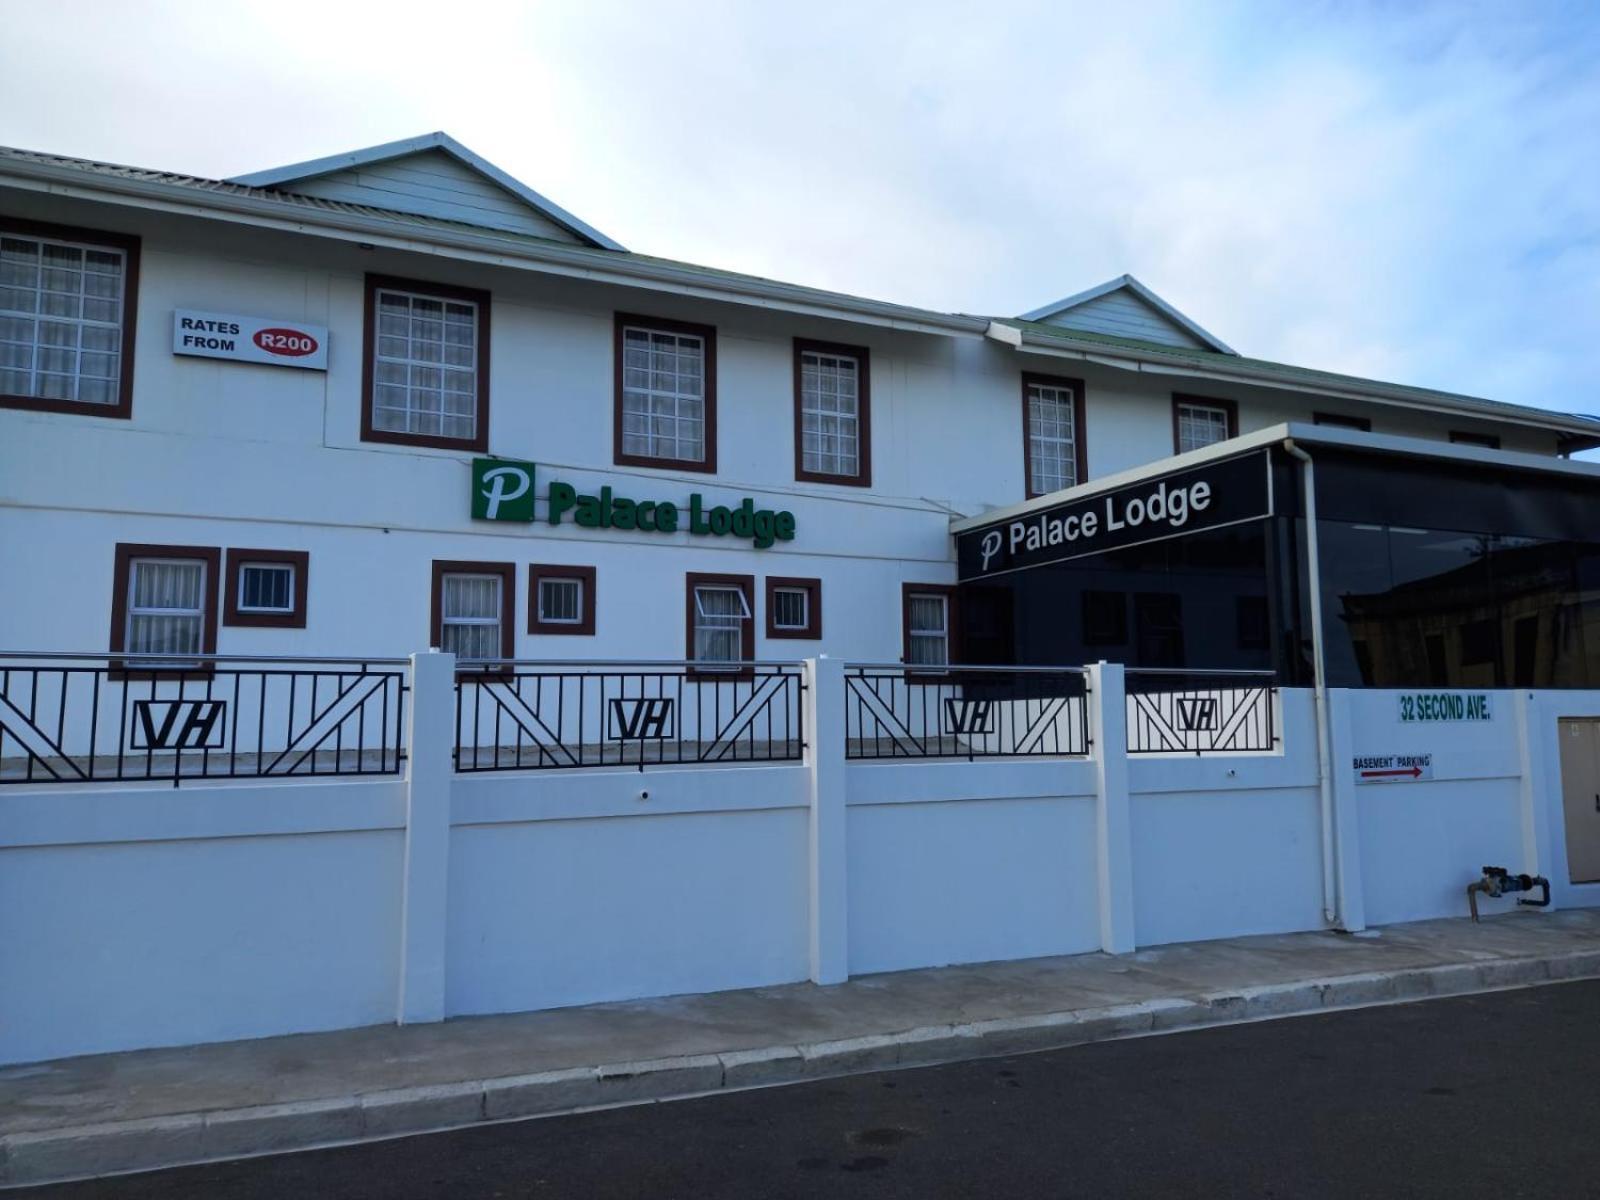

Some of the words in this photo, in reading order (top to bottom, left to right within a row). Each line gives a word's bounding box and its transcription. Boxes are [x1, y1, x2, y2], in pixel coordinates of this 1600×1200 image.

[181, 318, 239, 334] RATES
[183, 335, 235, 351] FROM
[260, 333, 312, 351] R200
[548, 482, 678, 532] Palace
[689, 493, 796, 549] Lodge
[1009, 511, 1098, 554] Palace
[1106, 481, 1212, 533] Lodge
[613, 700, 671, 738] VH
[947, 700, 991, 732] VH
[1178, 700, 1214, 730] VH
[1400, 695, 1415, 721] 32
[1417, 694, 1464, 721] SECOND
[1467, 695, 1491, 720] AVE.
[137, 702, 222, 748] VH
[1353, 757, 1393, 769] BASEMENT
[1397, 755, 1430, 768] PARKING
